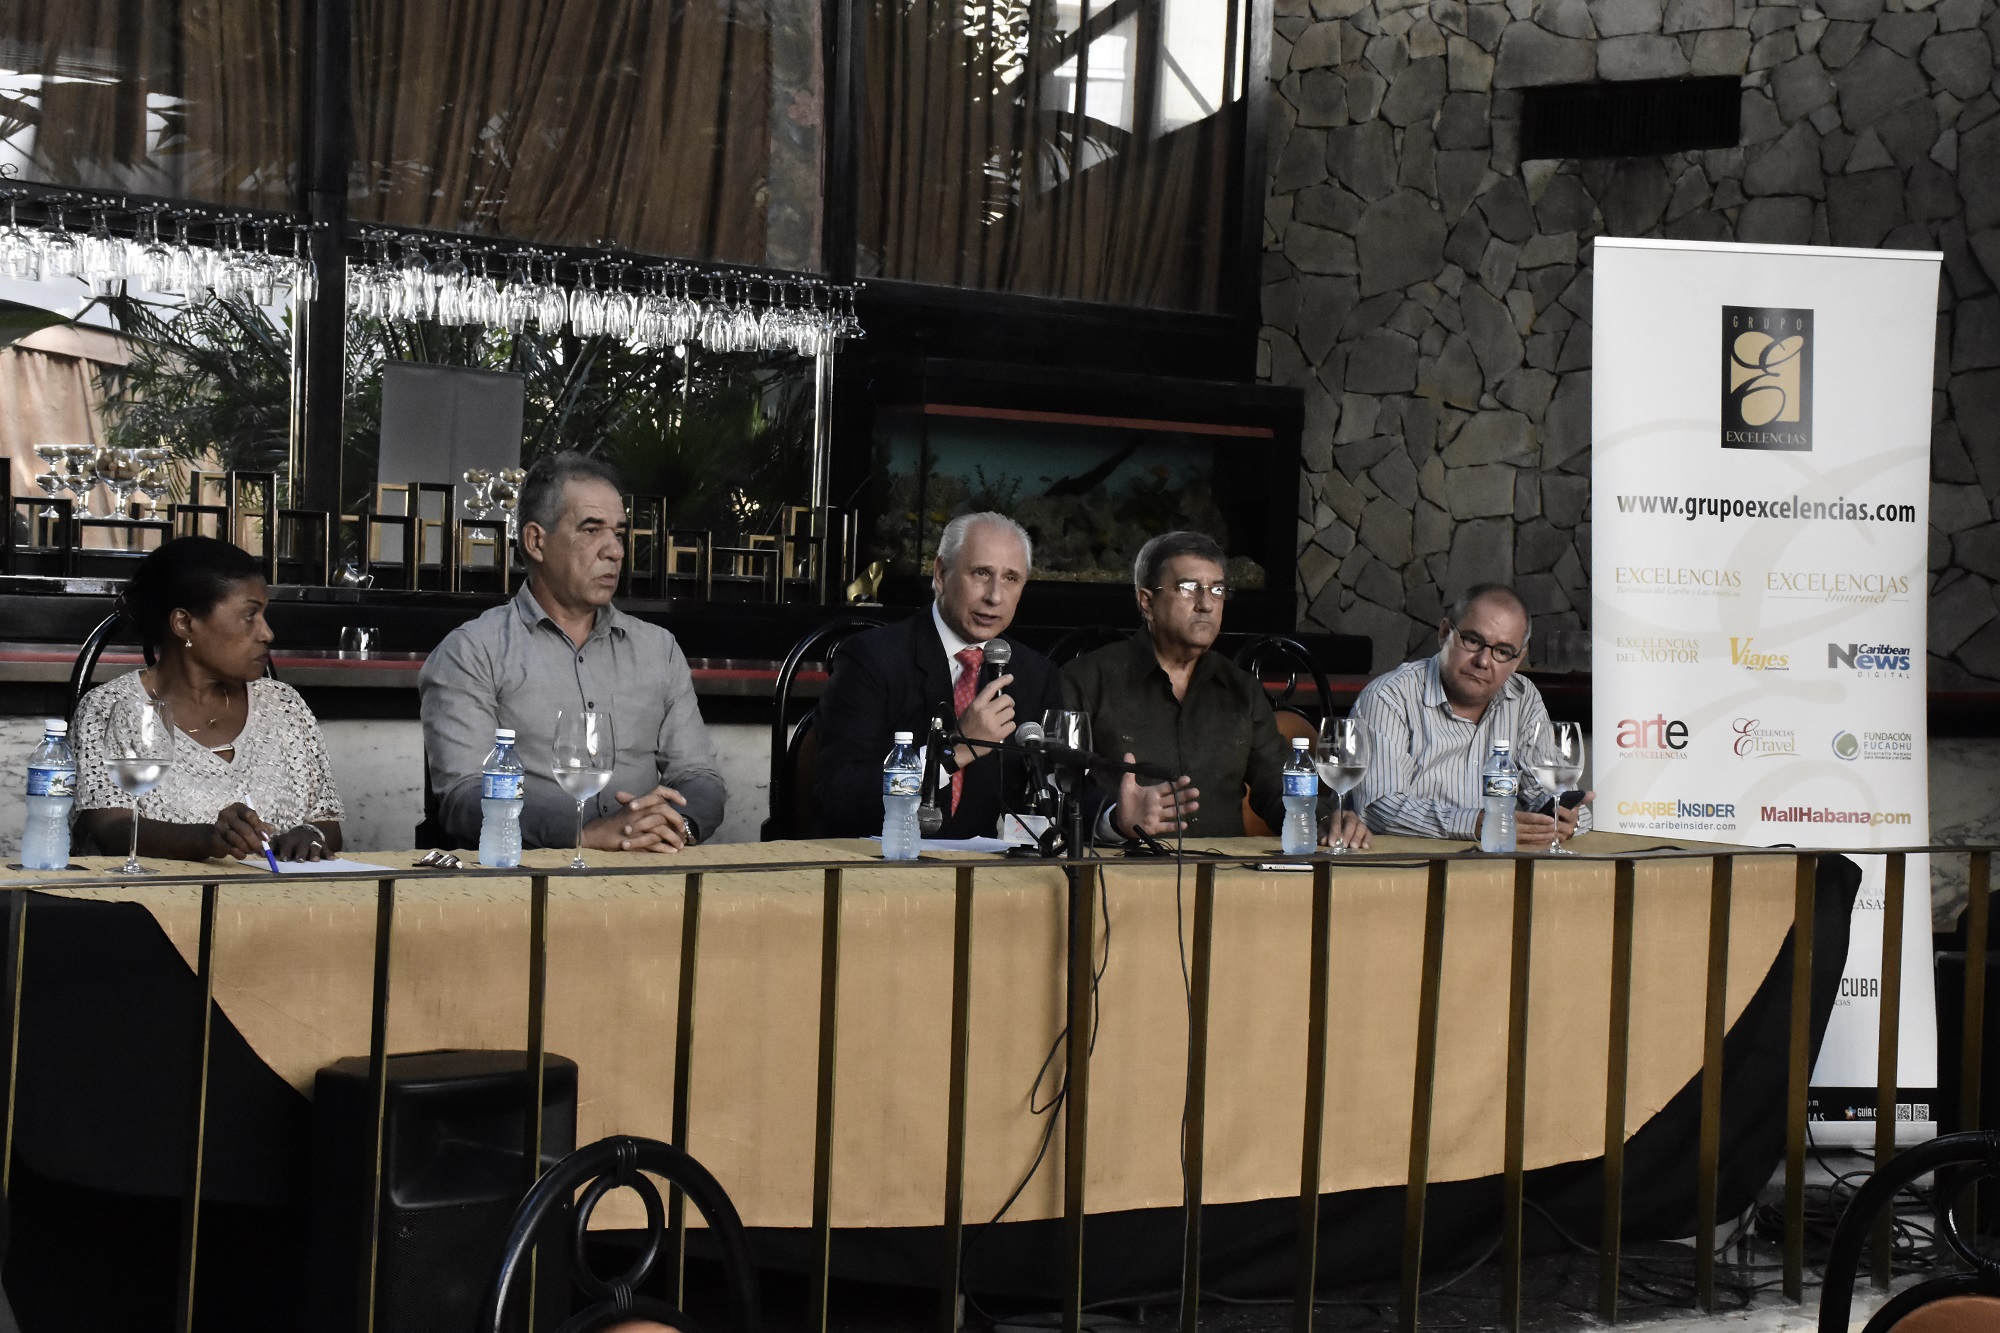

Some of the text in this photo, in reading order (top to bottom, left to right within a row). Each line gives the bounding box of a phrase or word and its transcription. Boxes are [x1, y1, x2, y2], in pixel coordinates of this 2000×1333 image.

[1732, 315, 1803, 331] GRUPO
[1726, 430, 1807, 445] EXCELENCIAS
[1616, 494, 1917, 523] www.grupoexcelencias.com
[1615, 567, 1742, 587] EXCELENCIAS
[1767, 572, 1909, 594] EXCELENCIAS
[1667, 587, 1690, 596] Caribe
[1825, 588, 1887, 604] Gourmet
[1616, 637, 1700, 649] EXCELENCIAS
[1858, 643, 1911, 656] Caribbean
[1616, 648, 1700, 664] DEL MOTOR
[1728, 636, 1789, 671] Viajes
[1827, 642, 1911, 671] News
[1857, 671, 1910, 679] DIGITAL
[1616, 713, 1689, 750] arte
[1864, 732, 1912, 741] FUNDACIÓN
[1752, 737, 1795, 752] Travel
[1864, 742, 1912, 751] FUCADHU
[1619, 751, 1688, 760] POR EXCELENCIAS
[1760, 805, 1912, 827] MallHabana.com
[1619, 820, 1737, 831] www.caribeinsider.com
[1840, 977, 1879, 998] CUBA
